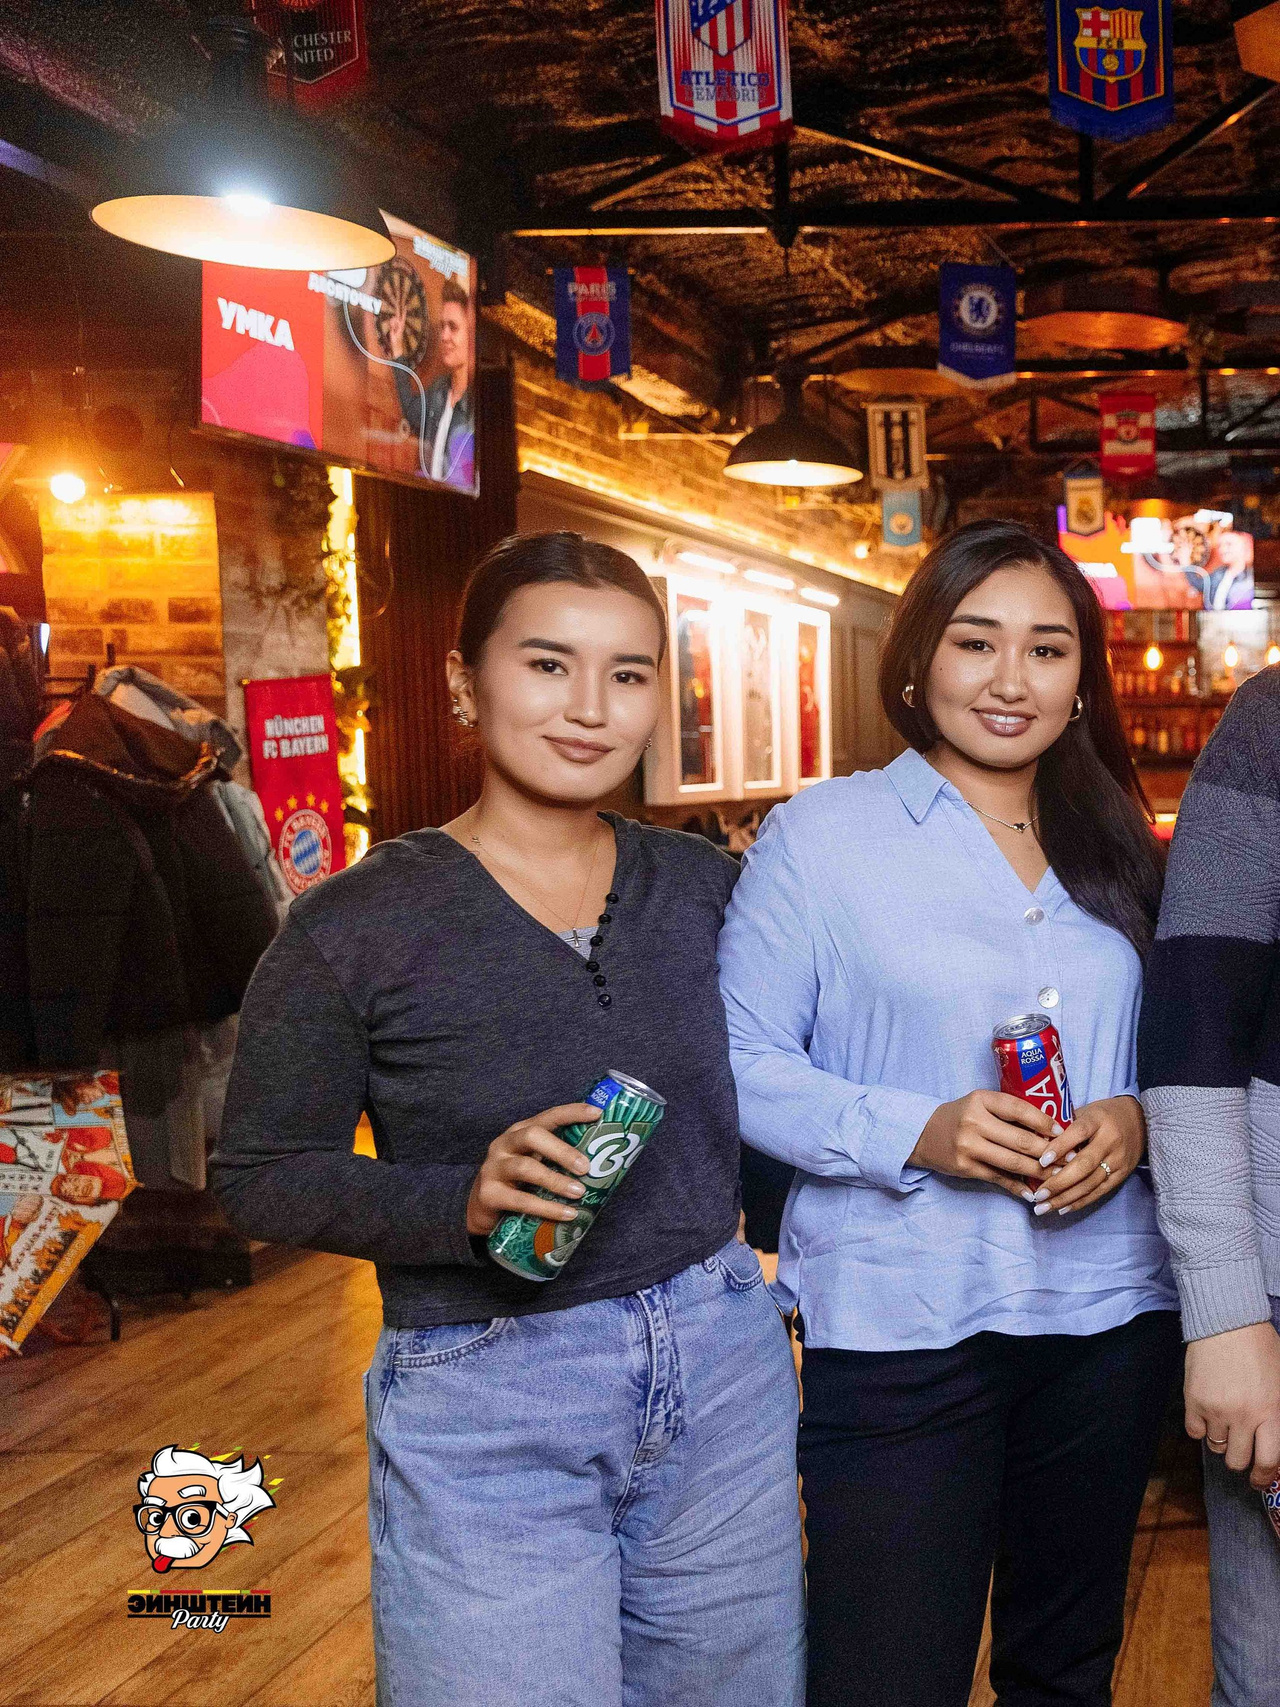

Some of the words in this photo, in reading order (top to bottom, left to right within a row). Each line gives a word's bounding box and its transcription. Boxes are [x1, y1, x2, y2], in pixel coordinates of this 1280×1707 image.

[293, 29, 352, 48] CHESTER
[292, 47, 335, 65] NITED
[217, 297, 295, 352] УМКА
[264, 714, 326, 738] MÜNCHEN
[262, 739, 279, 760] FC
[279, 734, 330, 759] BAYERN
[1020, 1053, 1045, 1065] ROSSA
[1021, 1047, 1043, 1059] AQUA
